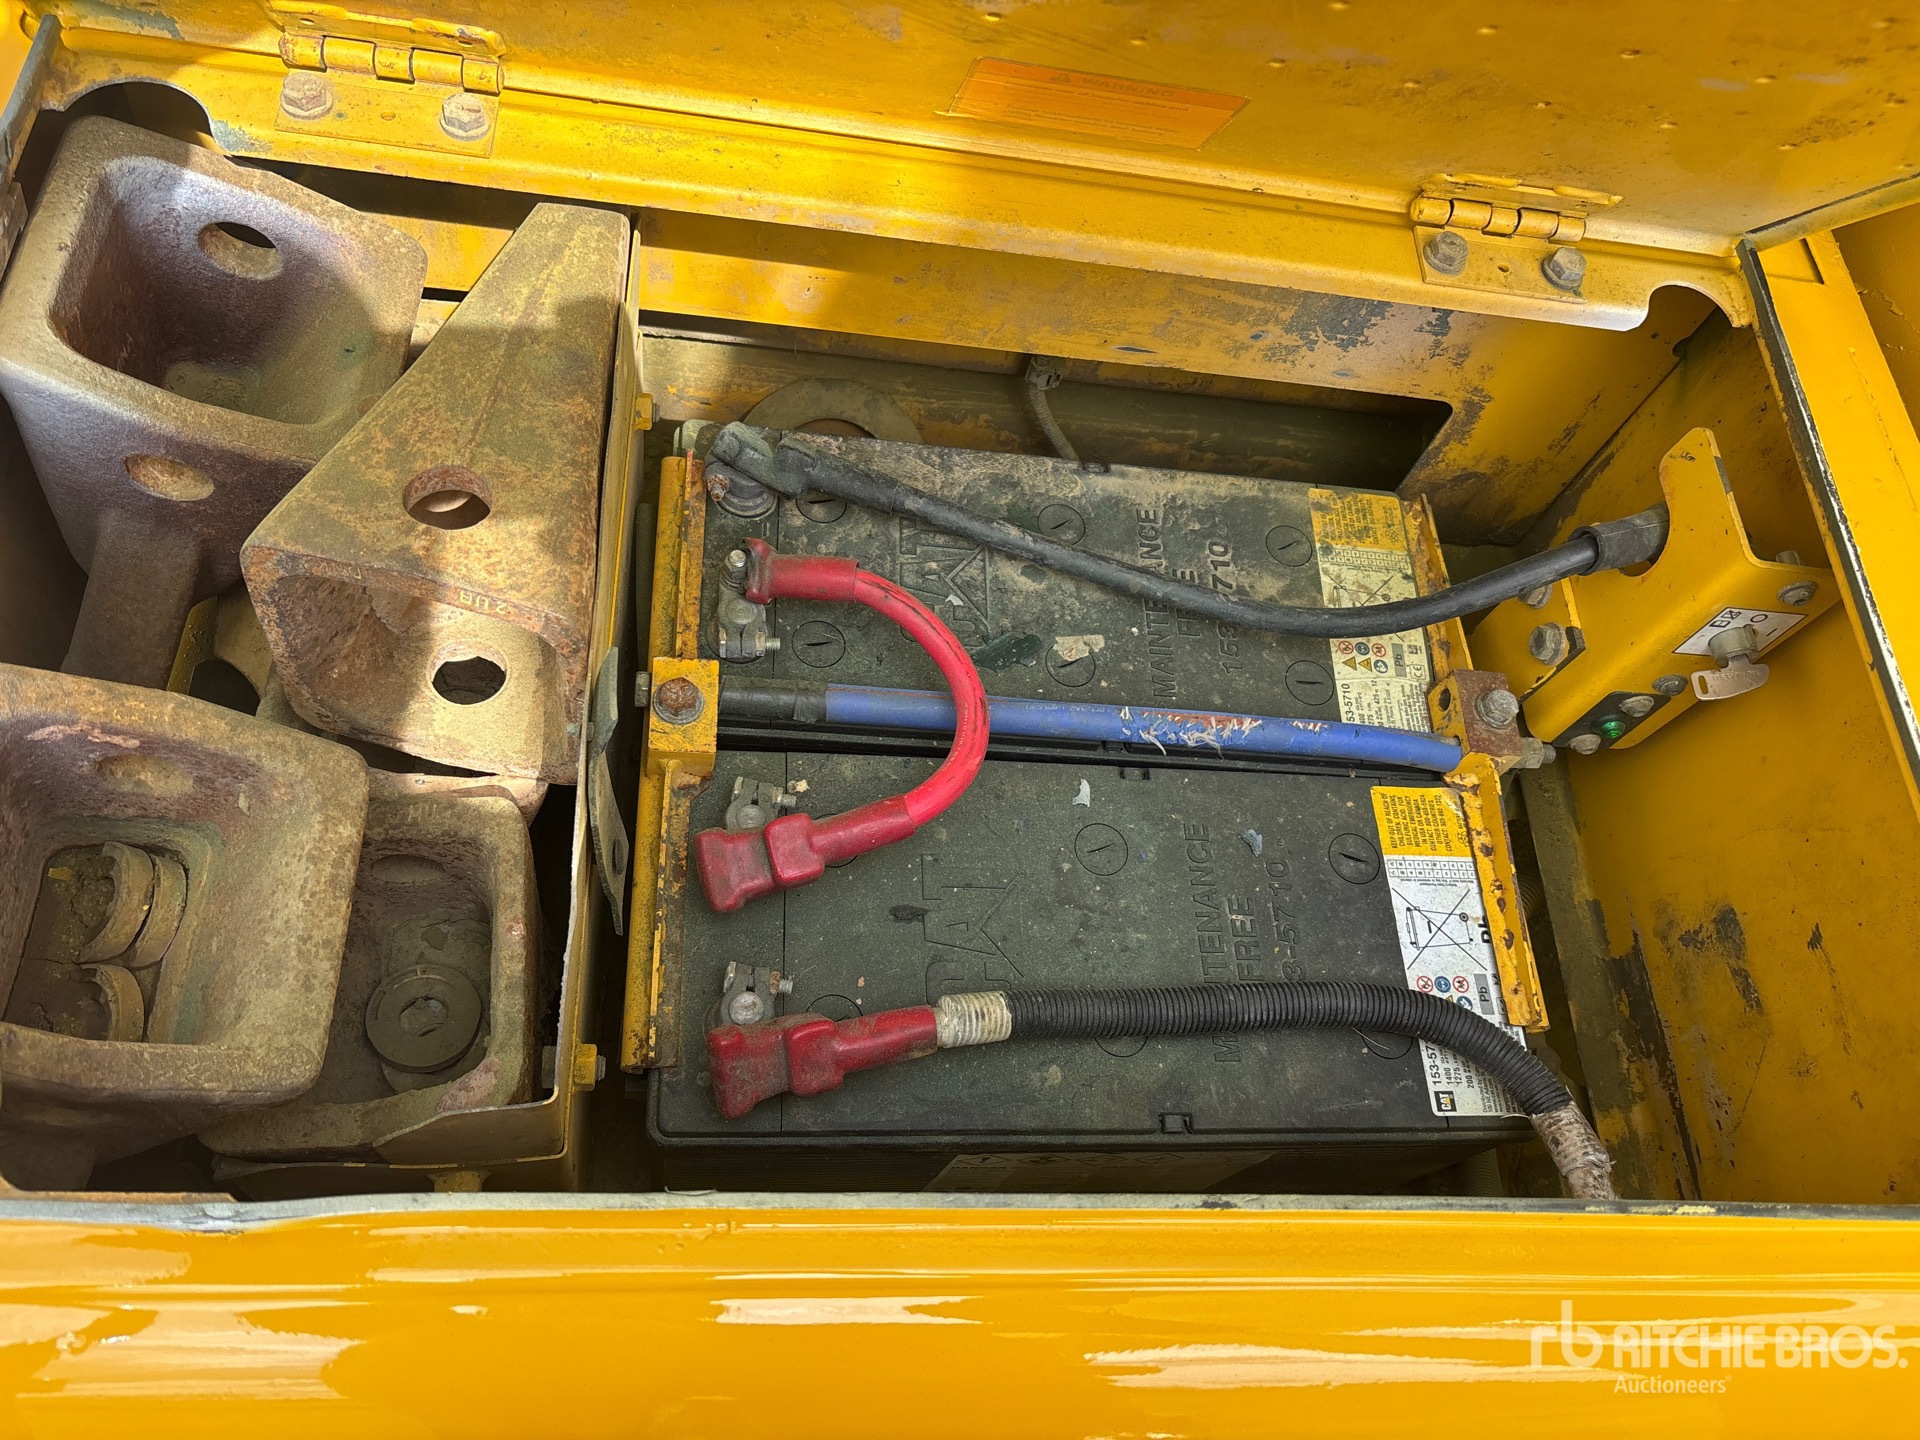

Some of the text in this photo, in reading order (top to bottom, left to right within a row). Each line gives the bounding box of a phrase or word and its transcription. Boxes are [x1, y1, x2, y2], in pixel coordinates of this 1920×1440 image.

[1136, 508, 1177, 698] MAINTEANCE
[1208, 541, 1243, 674] 153710
[1395, 654, 1403, 667] Pb
[1341, 683, 1355, 722] 53-5710
[1372, 694, 1380, 704] 425
[1358, 713, 1366, 724] 400
[1383, 801, 1391, 816] REACH
[1389, 795, 1400, 819] CONTAINS
[1397, 797, 1405, 806] FOR
[1413, 799, 1422, 818] CANADA
[1405, 796, 1421, 847] MEDICAL EMERGENCY
[1428, 800, 1443, 844] OTHER COUNTRIES
[1390, 836, 1398, 848] KEEP
[1402, 822, 1413, 846] SULFURIC
[1418, 828, 1426, 837] USA
[1265, 860, 1303, 982] 3-5710
[1183, 823, 1241, 1062] MTENANCE
[1226, 897, 1264, 982] FREE
[1479, 986, 1489, 1002] Pb
[1426, 1041, 1441, 1086] 153-57
[1444, 1067, 1454, 1085] 1400
[1454, 1067, 1463, 1085] 1275
[1466, 1075, 1474, 1089] 200
[1481, 1077, 1489, 1094] Adams
[1439, 1093, 1451, 1109] CAT
[1477, 1086, 1487, 1113] Distributed
[1488, 1078, 1498, 1112] www.cat.com
